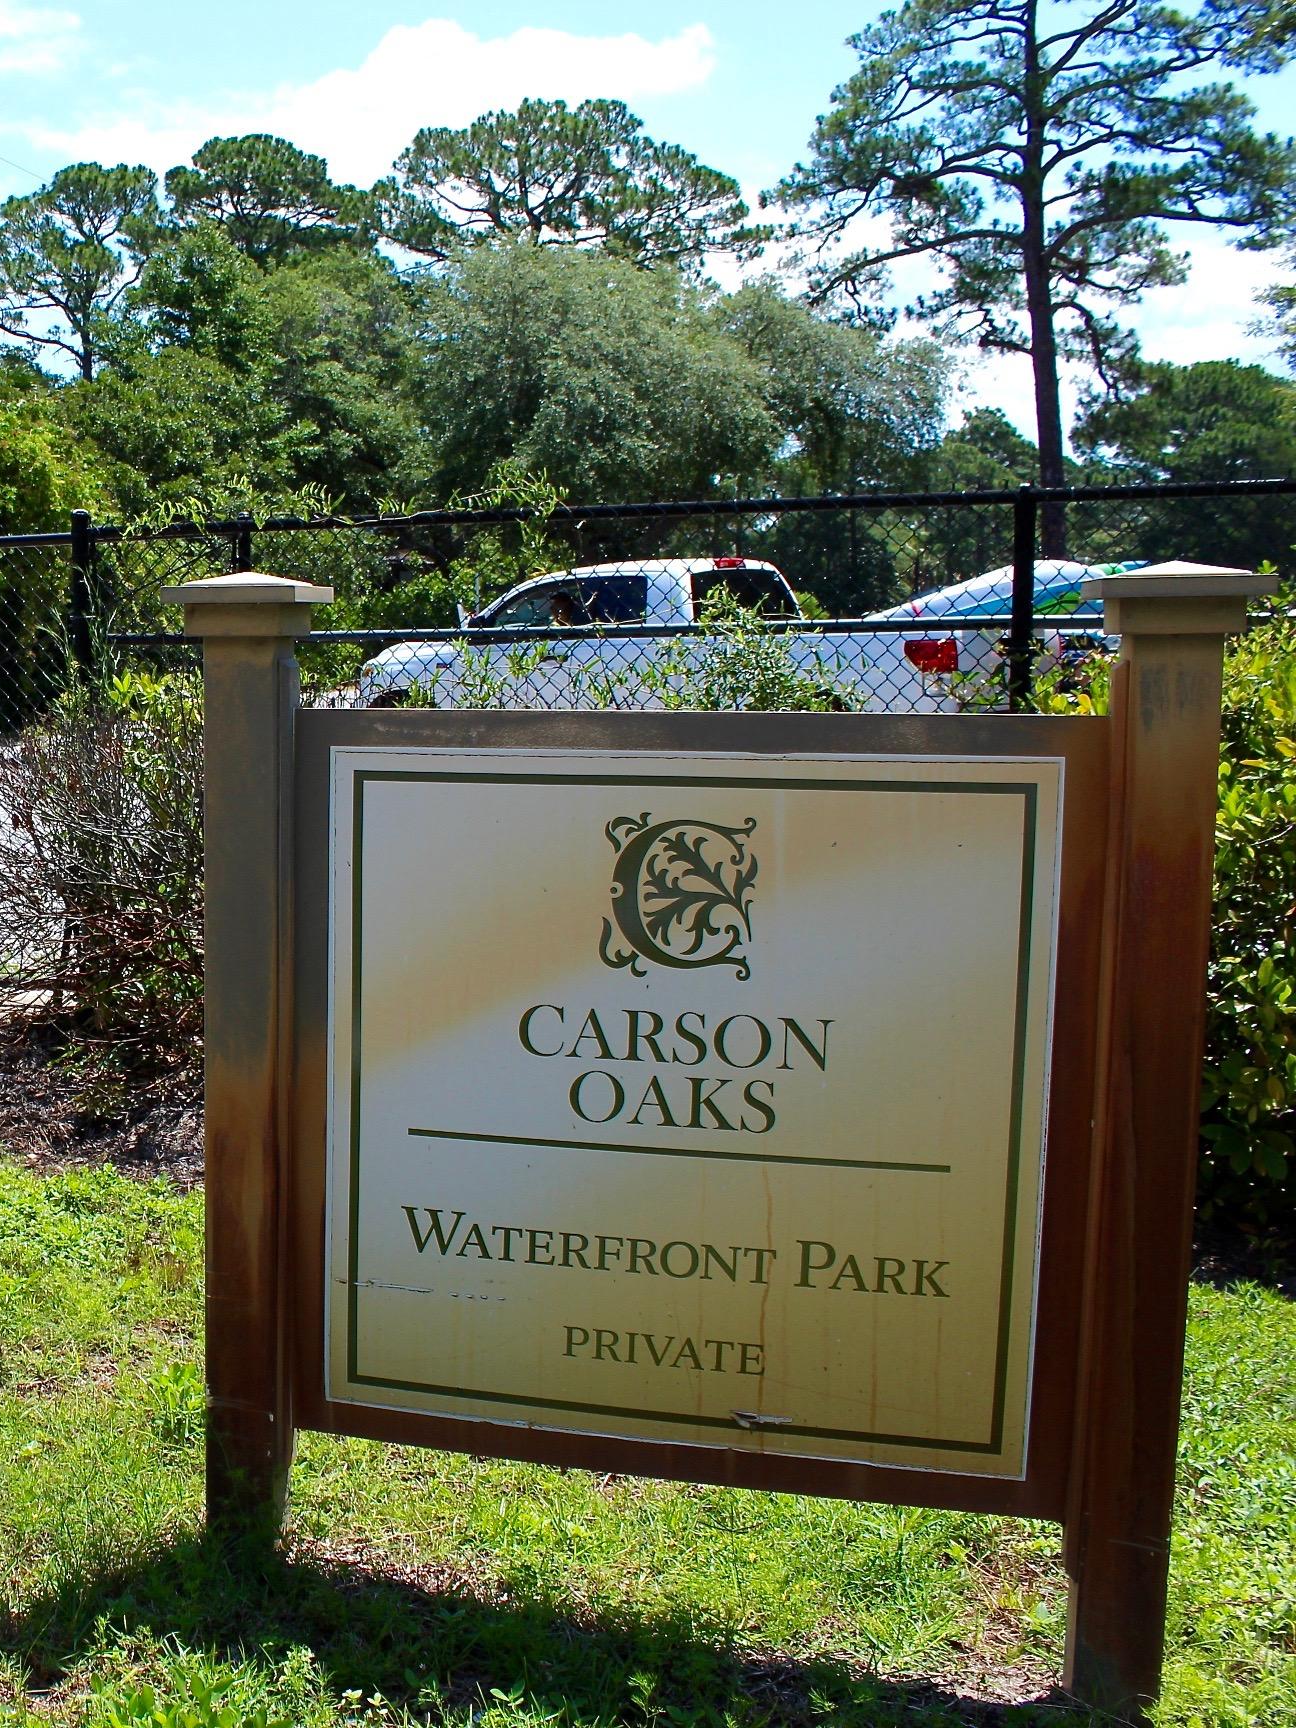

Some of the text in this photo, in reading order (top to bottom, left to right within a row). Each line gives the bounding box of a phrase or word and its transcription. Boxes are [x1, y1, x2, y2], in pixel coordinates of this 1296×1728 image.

[518, 1004, 835, 1072] CARSON
[568, 1070, 776, 1133] OAKS
[401, 1205, 951, 1298] WATERFRONT PARK
[562, 1325, 766, 1377] PRIVATE
